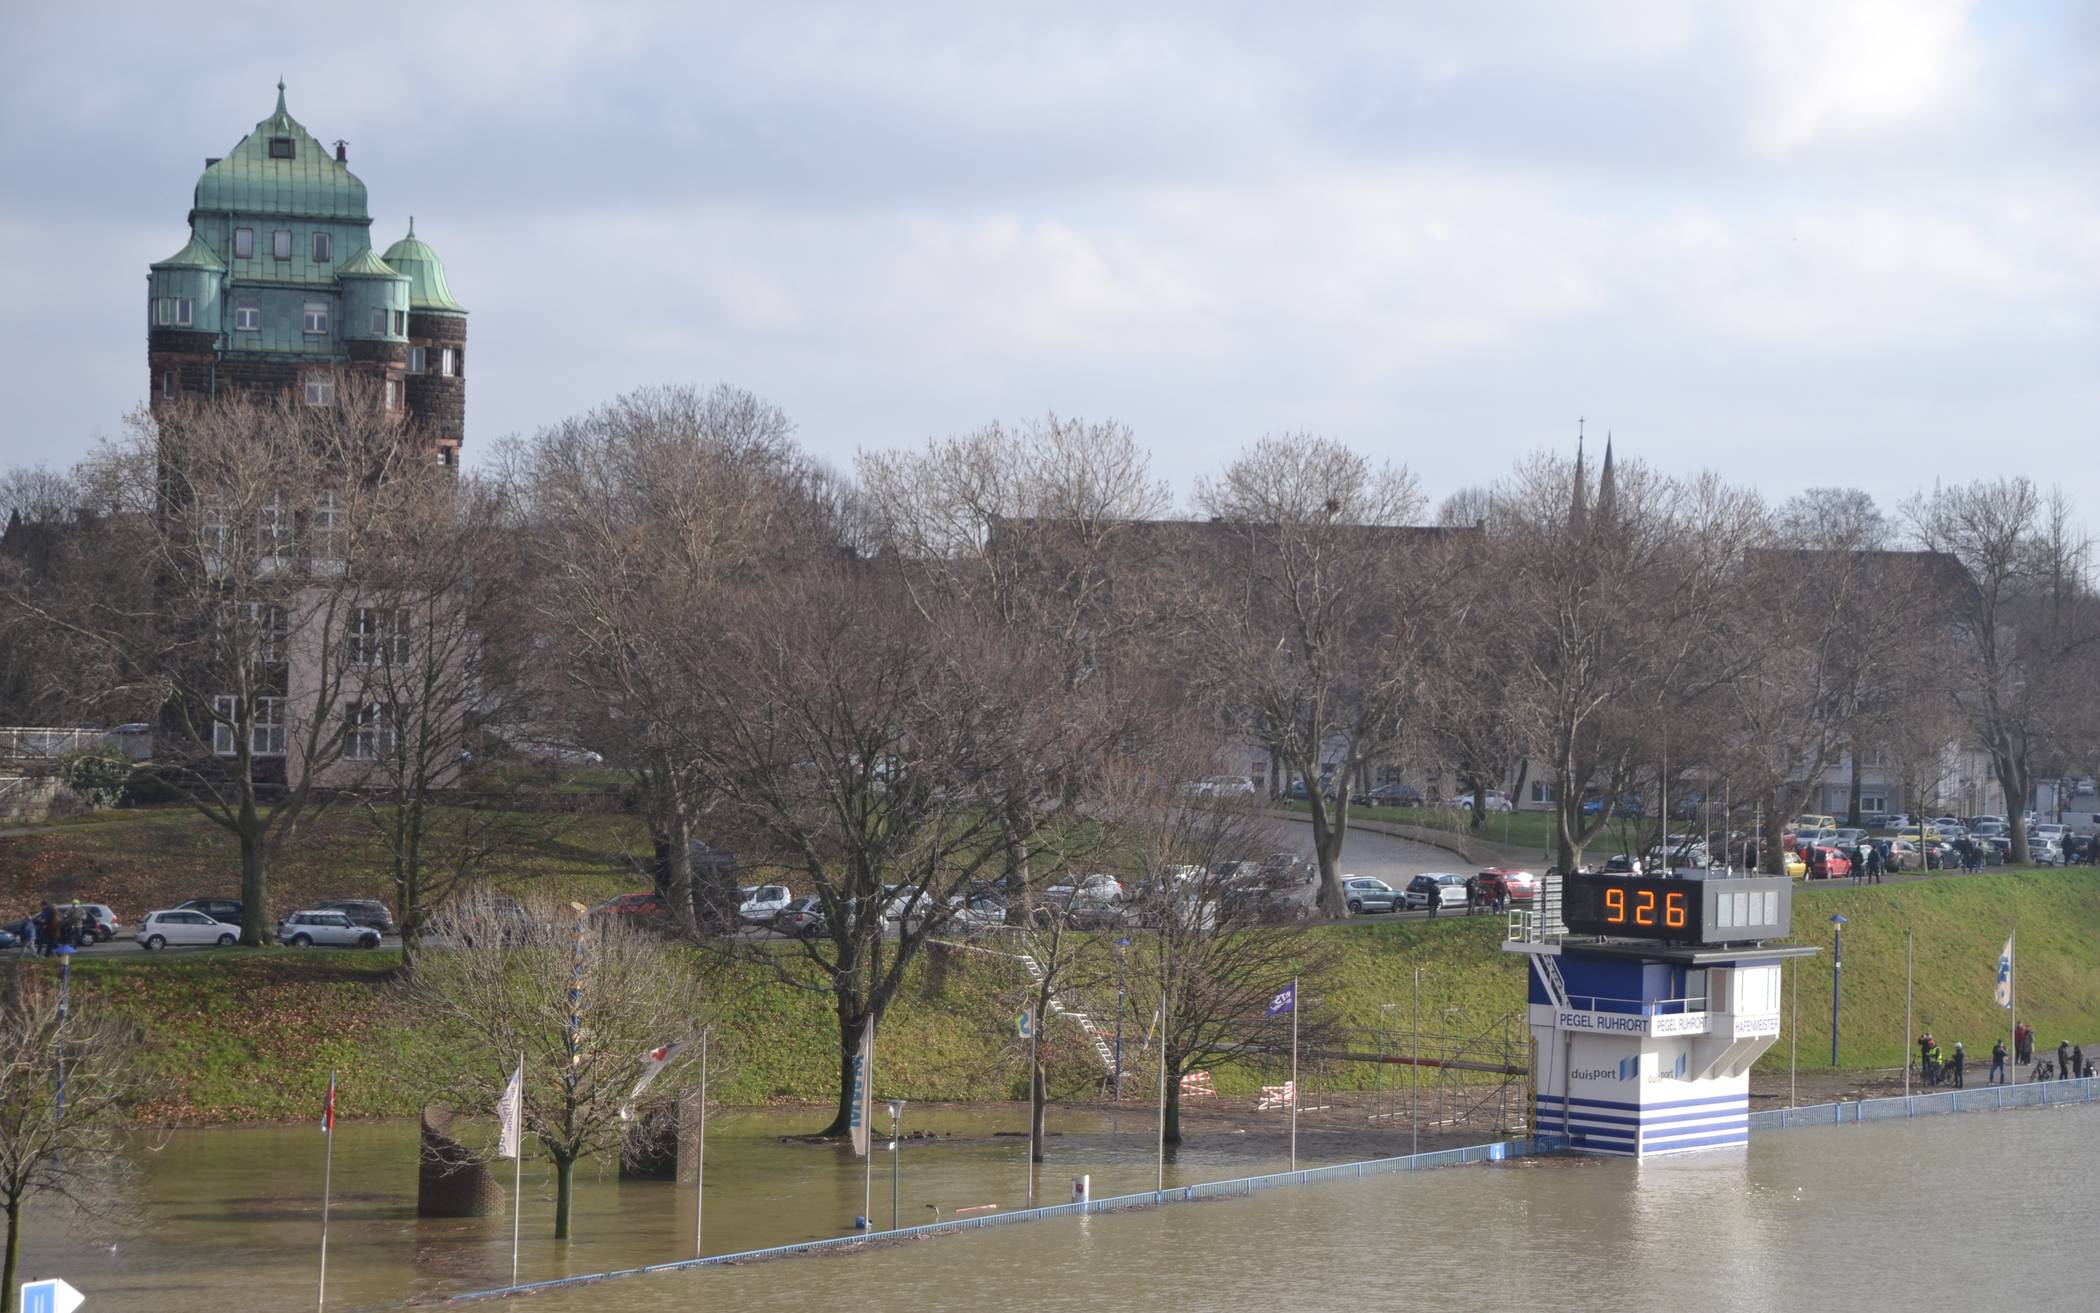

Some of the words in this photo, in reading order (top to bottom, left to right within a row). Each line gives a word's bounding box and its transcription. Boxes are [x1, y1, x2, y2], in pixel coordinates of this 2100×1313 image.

[1606, 888, 1685, 927] 926
[1560, 1013, 1594, 1028] PEGEL
[1597, 1016, 1648, 1032] RUHRORT
[1657, 1018, 1678, 1032] PEGEL
[1679, 1016, 1707, 1031] RUHRORT
[1735, 1017, 1779, 1034] HAFENMEISTER
[1571, 1069, 1616, 1080] duisport
